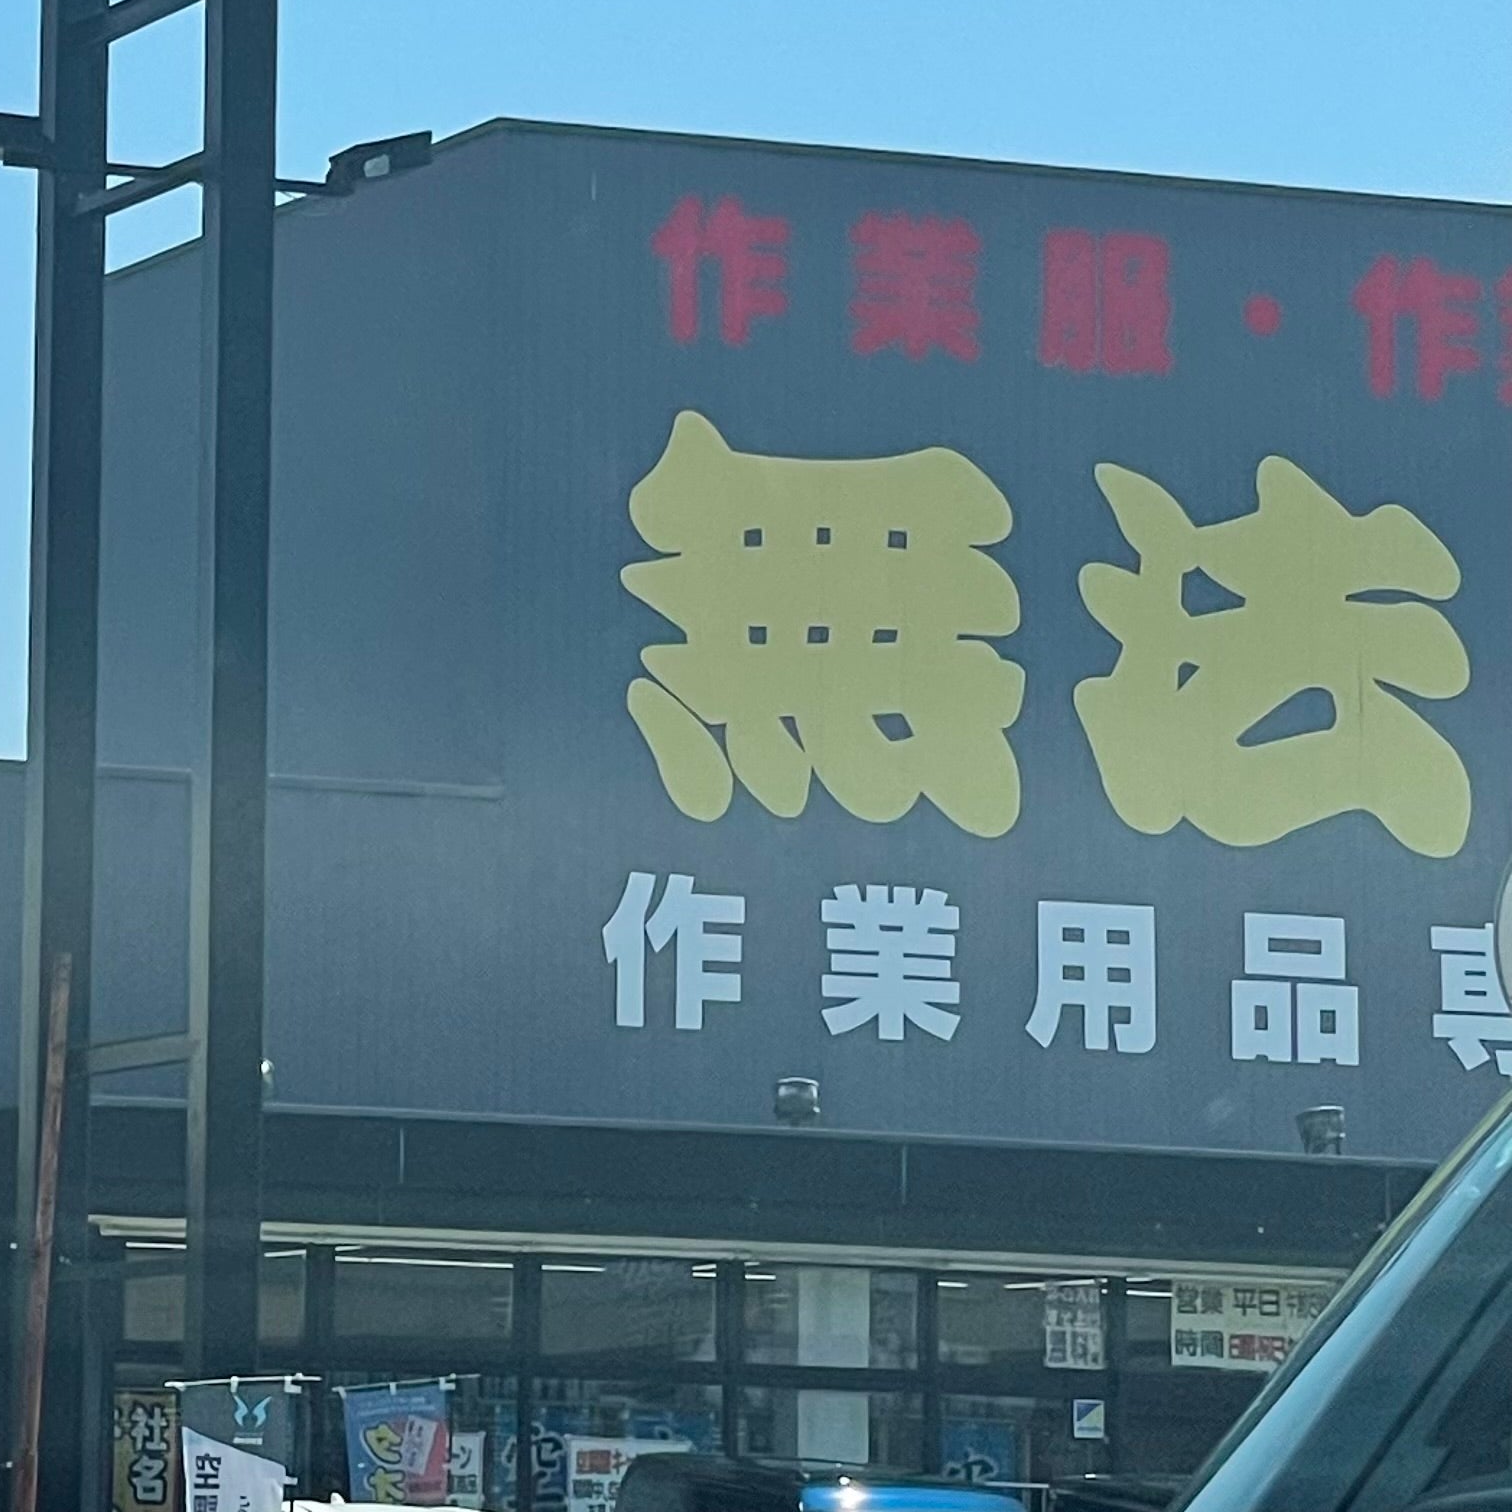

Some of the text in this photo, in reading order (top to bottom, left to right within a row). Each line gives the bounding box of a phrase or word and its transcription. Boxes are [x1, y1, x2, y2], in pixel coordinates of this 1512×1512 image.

[650, 194, 1512, 404] 作業服・作
[619, 410, 1472, 858] 無法
